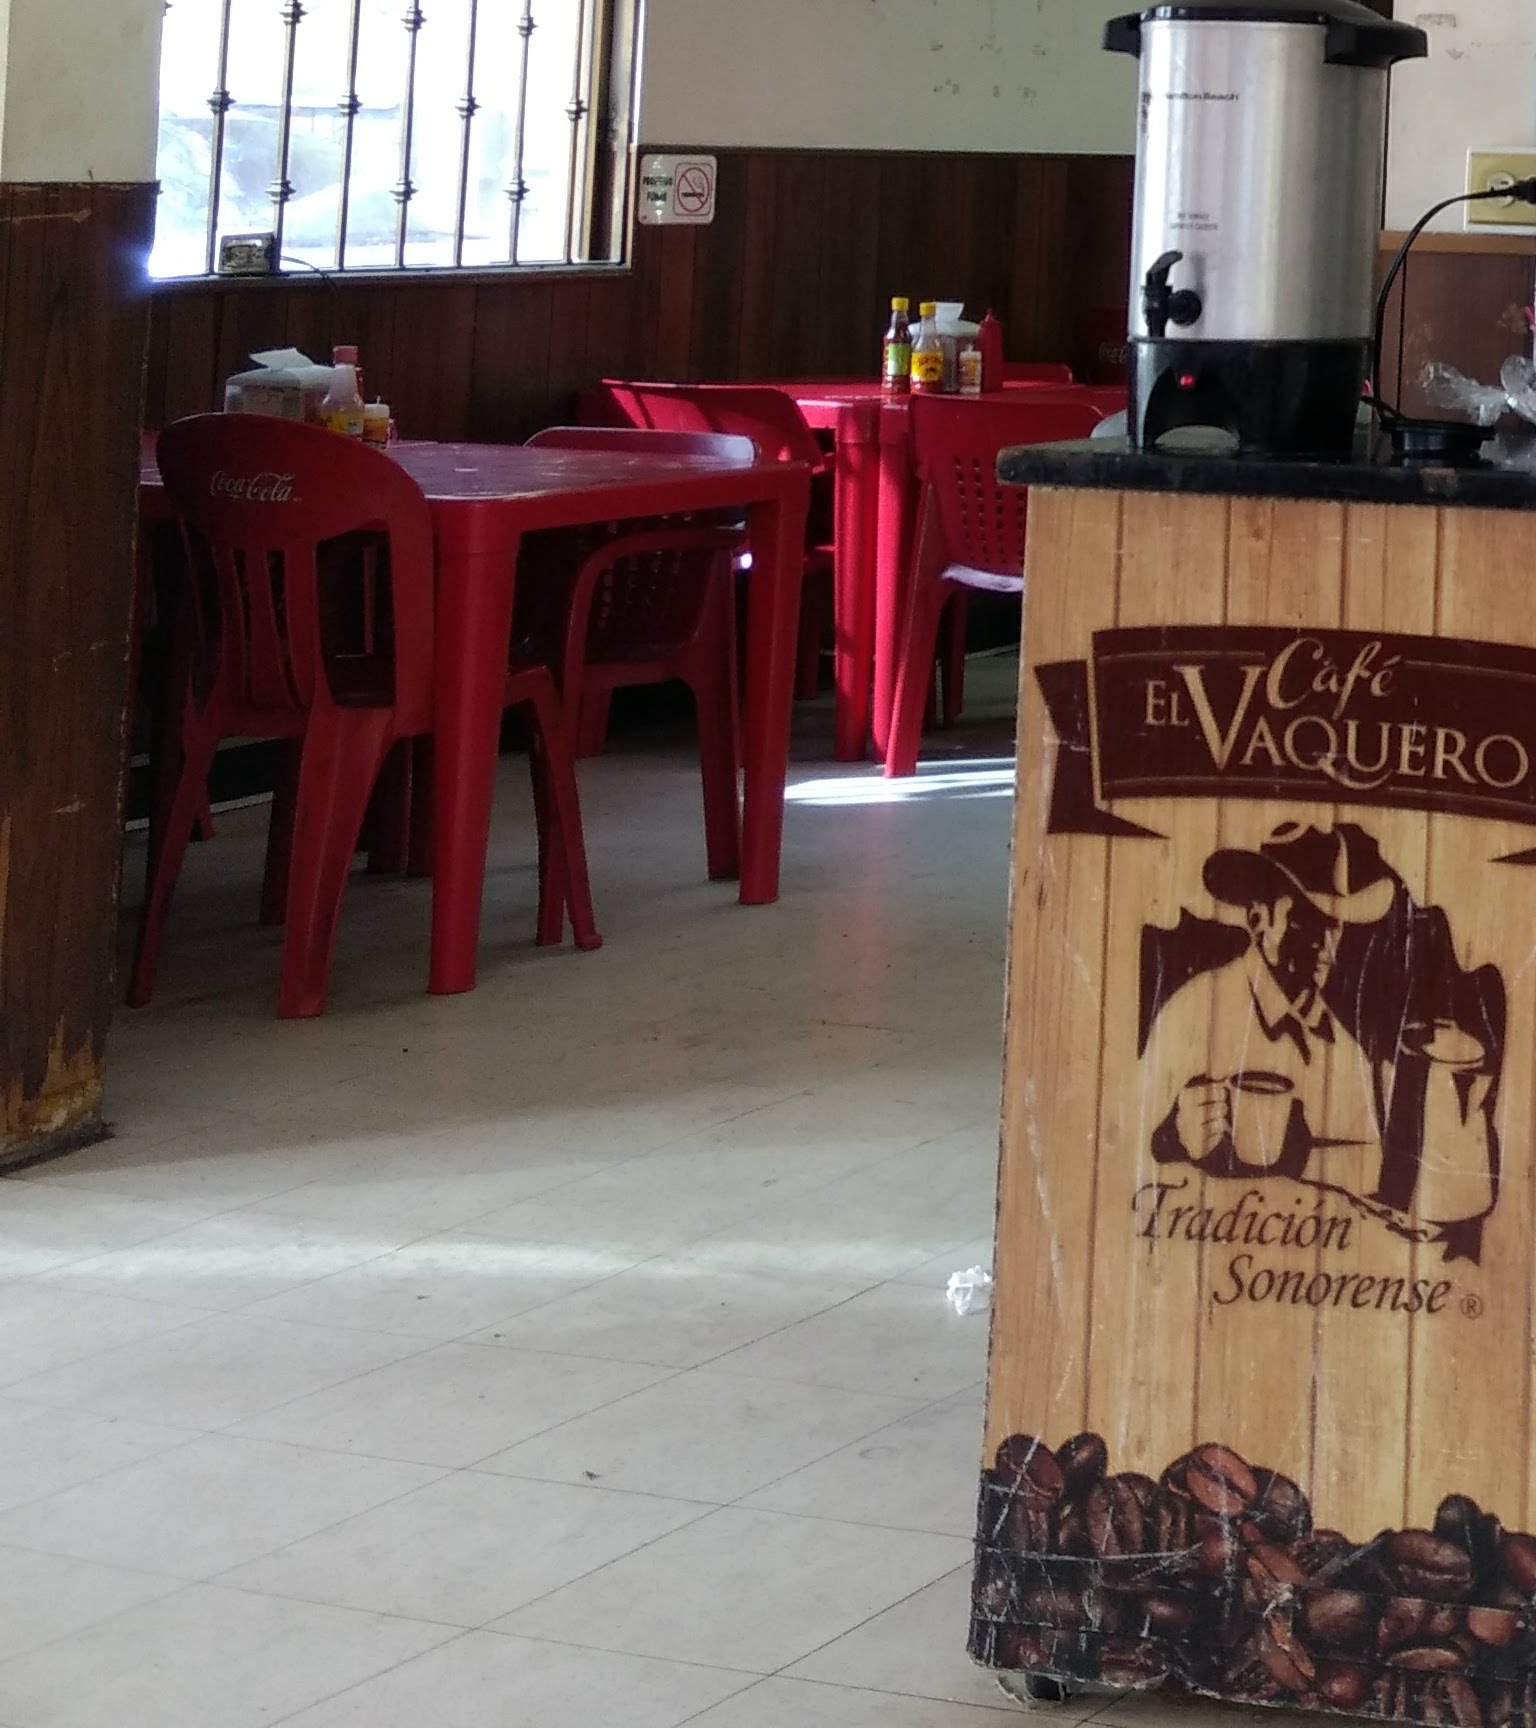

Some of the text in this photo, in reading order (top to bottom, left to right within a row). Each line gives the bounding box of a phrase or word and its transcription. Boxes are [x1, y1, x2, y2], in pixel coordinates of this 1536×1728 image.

[209, 470, 296, 502] Coca-Cola
[1265, 635, 1402, 721] Café
[1130, 1182, 1355, 1254] Tradición
[1212, 1255, 1452, 1318] Sonorense
